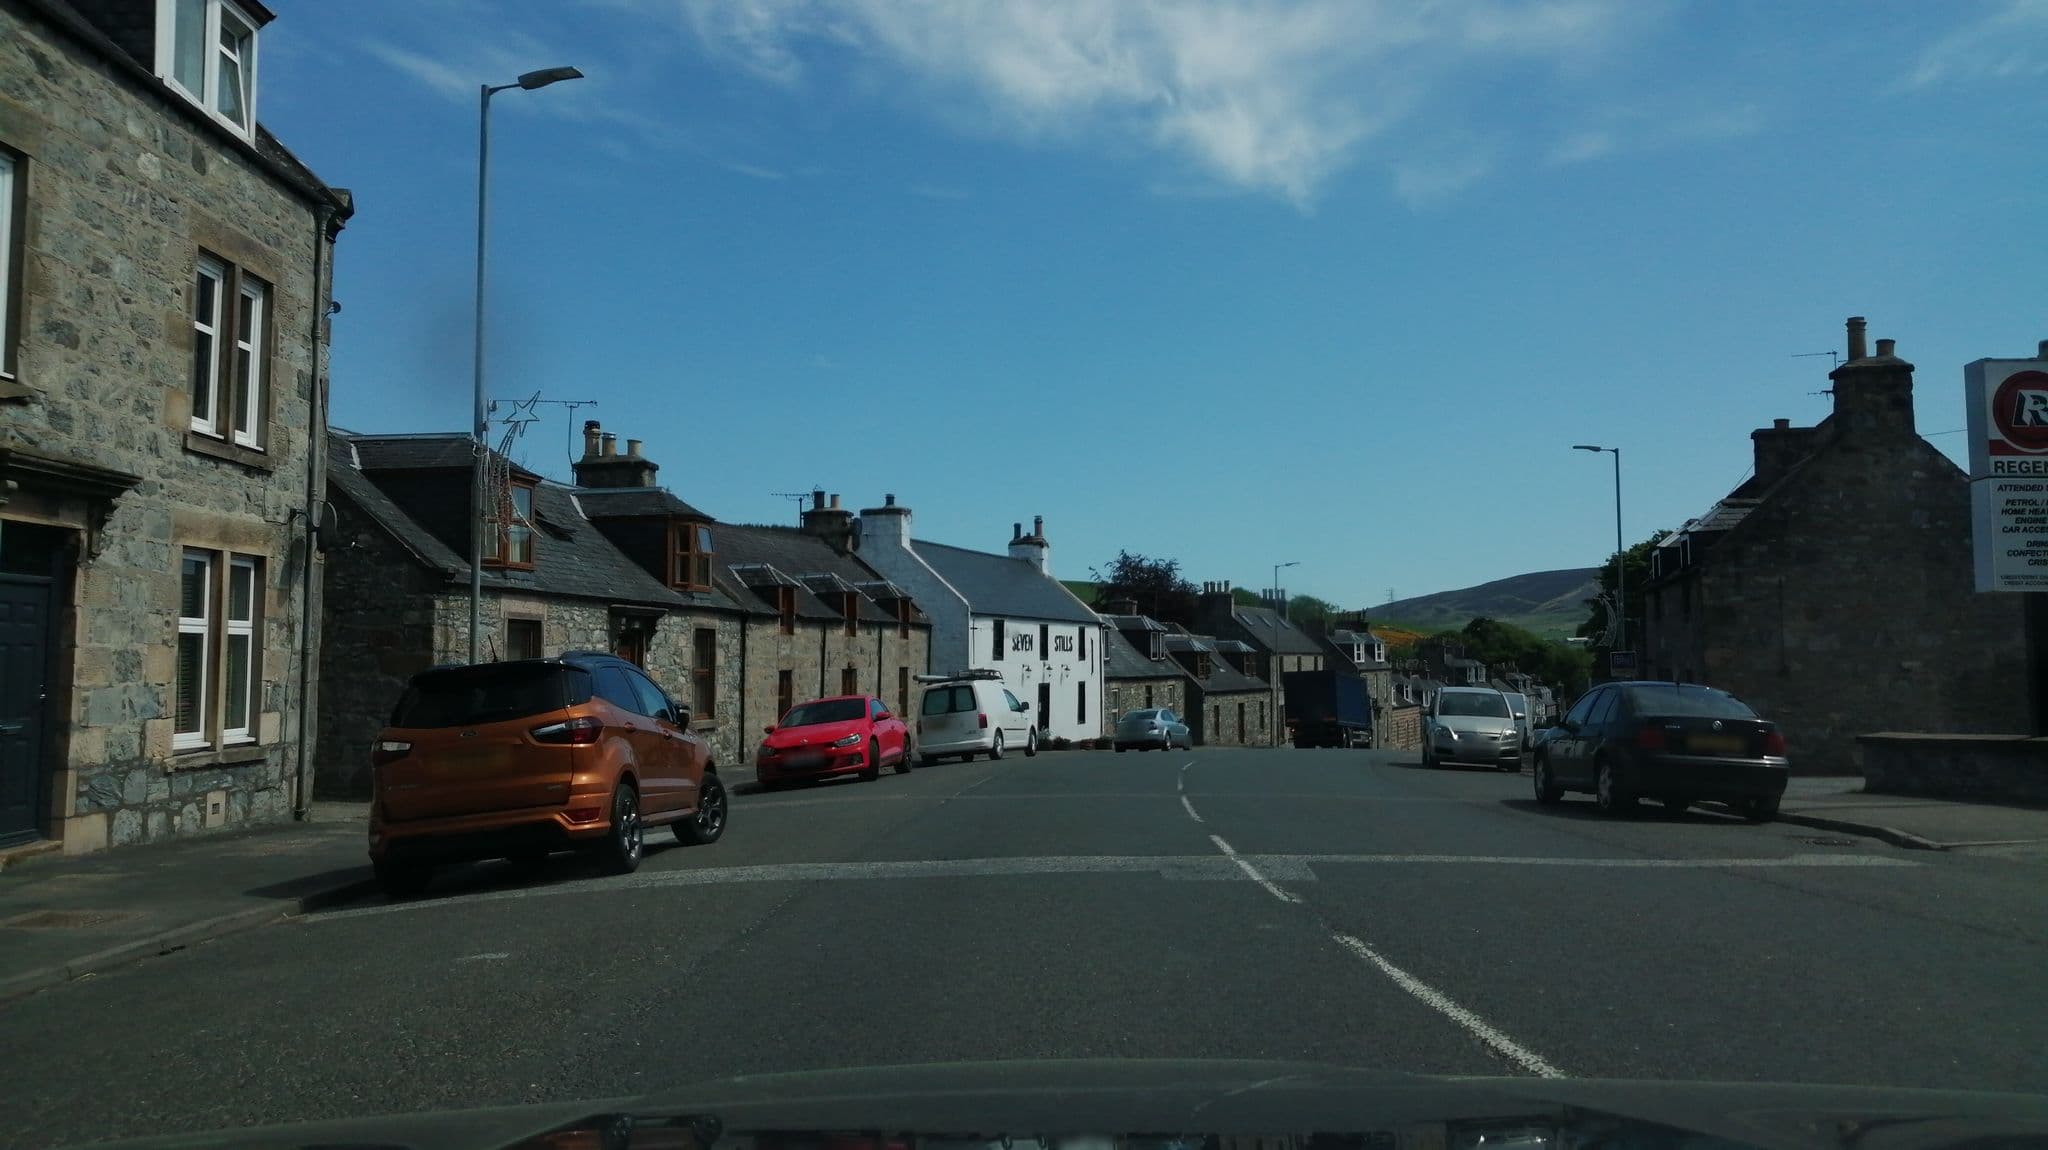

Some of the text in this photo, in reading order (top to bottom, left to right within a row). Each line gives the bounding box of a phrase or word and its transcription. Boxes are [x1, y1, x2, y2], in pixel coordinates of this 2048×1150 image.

[1997, 484, 2044, 492] ATTENDED
[2005, 498, 2039, 506] PETROL
[2001, 507, 2048, 516] HOME HEA
[2015, 516, 2048, 524] ENGINE
[2002, 525, 2020, 533] CAR
[1012, 634, 1073, 652] SEVEN STILLS
